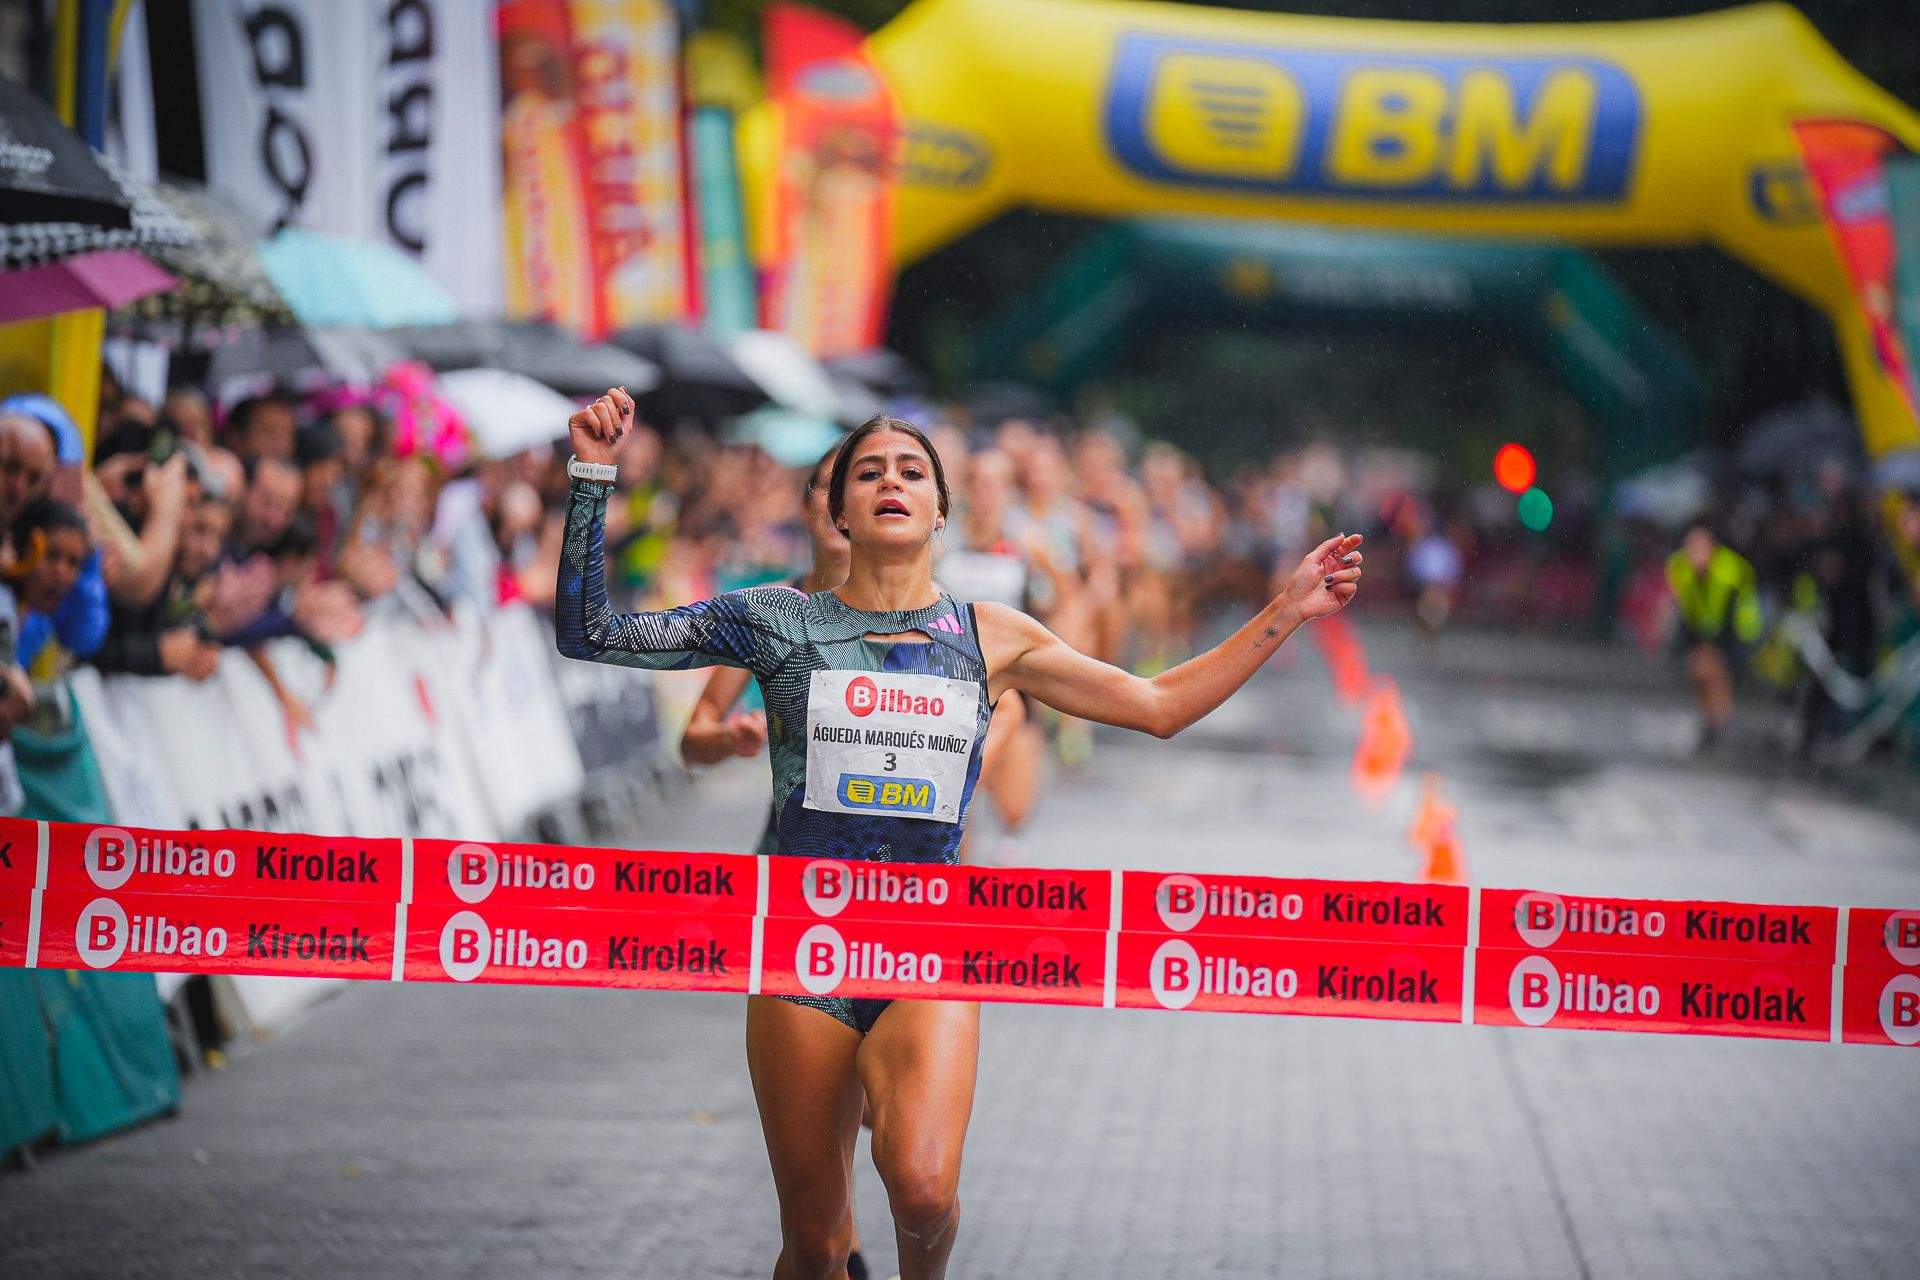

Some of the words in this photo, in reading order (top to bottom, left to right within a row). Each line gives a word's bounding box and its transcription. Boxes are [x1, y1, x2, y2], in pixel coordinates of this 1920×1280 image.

[1332, 63, 1595, 190] BM
[852, 684, 945, 717] Bilbao
[813, 723, 861, 744] ÁGUEDA
[865, 729, 925, 749] MARQUÉS
[928, 733, 968, 754] MUÑOZ
[883, 752, 897, 772] 3
[880, 780, 930, 809] BM
[97, 837, 236, 878] Bilbao
[255, 845, 379, 884] Kirolak
[460, 853, 596, 891] Bilbao
[613, 861, 734, 896] Kirolak
[814, 867, 949, 905] Bilbao
[967, 875, 1089, 911] Kirolak
[1168, 884, 1304, 920] Bilbao
[1322, 892, 1445, 927] Kirolak
[88, 915, 228, 957] Bilbao
[246, 923, 370, 962] Kirolak
[1528, 901, 1666, 938] Bilbao
[1685, 908, 1812, 945] Kirolak
[452, 928, 588, 970] Bilbao
[606, 936, 728, 974] Kirolak
[809, 941, 943, 983] Bilbao
[961, 950, 1082, 988] Kirolak
[1163, 956, 1298, 999] Bilbao
[1317, 965, 1439, 1005] Kirolak
[1522, 973, 1661, 1016] Bilbao
[1680, 982, 1807, 1023] Kirolak
